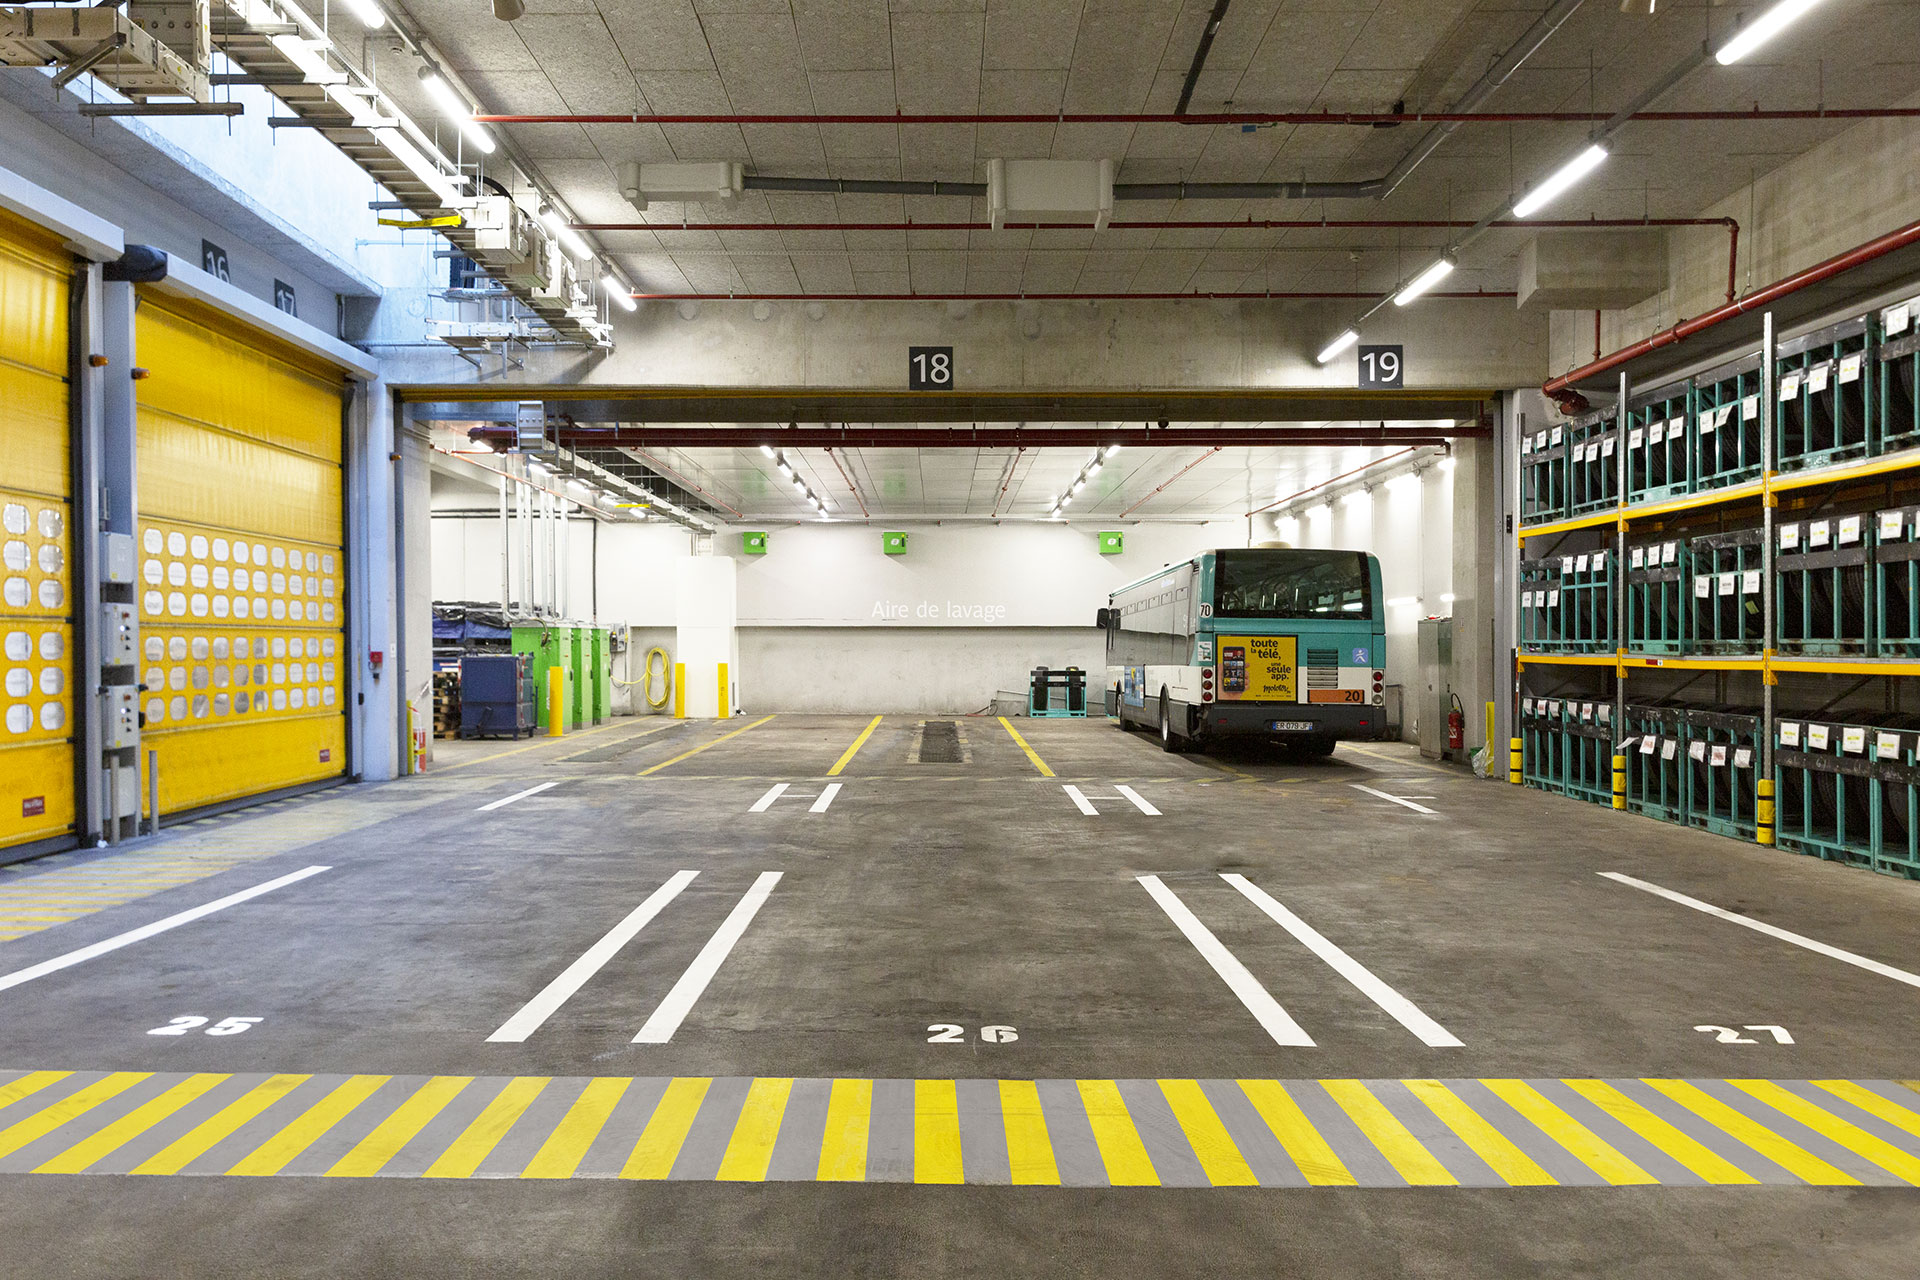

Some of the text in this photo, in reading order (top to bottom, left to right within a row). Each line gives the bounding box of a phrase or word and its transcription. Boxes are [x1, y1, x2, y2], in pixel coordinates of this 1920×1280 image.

[207, 251, 229, 283] 16
[278, 290, 295, 315] 17
[913, 353, 950, 384] 18
[1362, 351, 1399, 382] 19
[871, 600, 1006, 622] Aire de lavage
[1200, 605, 1211, 617] 70
[1250, 639, 1278, 648] toute
[1258, 648, 1281, 660] télé,
[1266, 665, 1291, 674] seule
[1271, 673, 1289, 681] app.
[1344, 690, 1360, 701] 20
[146, 1015, 264, 1036] 25
[927, 1024, 1019, 1043] 26
[1693, 1024, 1795, 1044] 27
